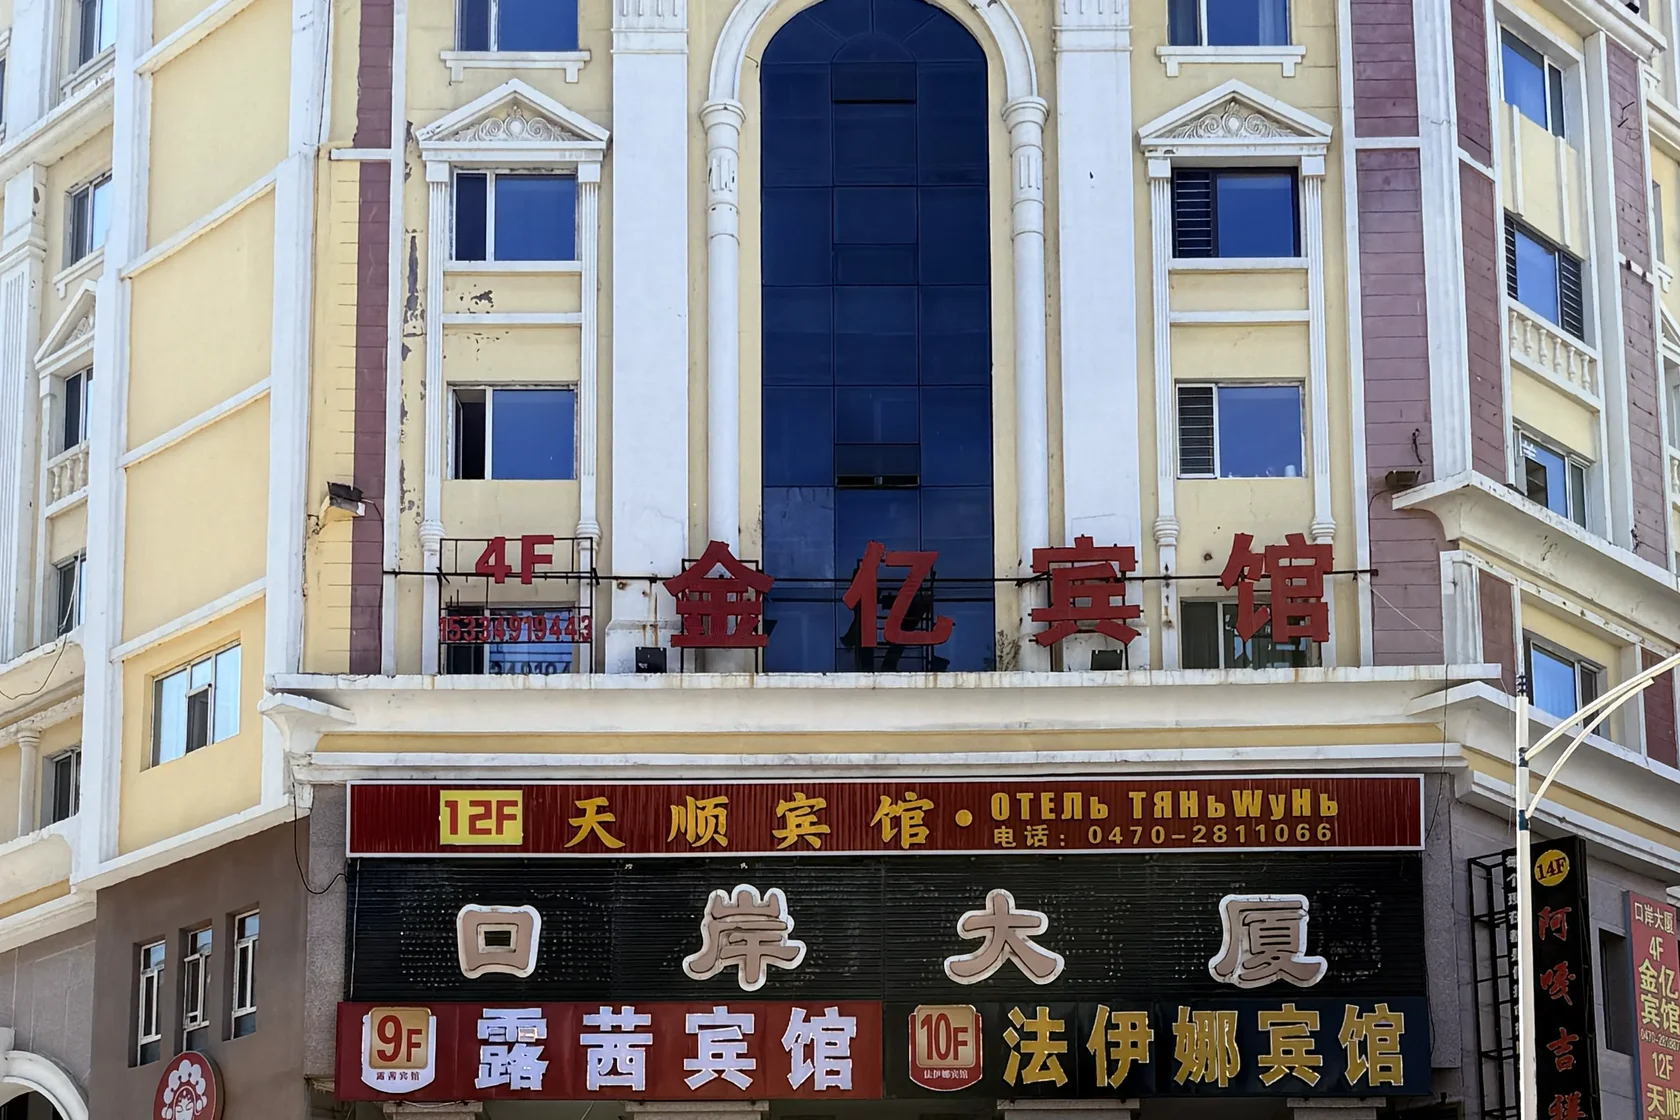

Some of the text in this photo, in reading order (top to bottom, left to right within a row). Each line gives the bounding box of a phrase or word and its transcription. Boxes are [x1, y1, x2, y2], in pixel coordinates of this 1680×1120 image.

[474, 535, 555, 586] 4F
[663, 533, 1334, 648] 金亿宾馆
[444, 799, 520, 838] 12F
[564, 791, 935, 850] 天顺宾馆
[1088, 822, 1333, 846] 0470-2811066
[1536, 856, 1567, 880] 14F
[456, 883, 1328, 992] 口岸大厦
[1634, 900, 1676, 935] 口岸大厦
[1648, 936, 1665, 962] 4F
[375, 1014, 424, 1064] 9F
[475, 1004, 857, 1092] 露茜宾馆
[919, 1012, 969, 1062] 10F
[1001, 1002, 1405, 1089] 法伊娜宾馆
[1651, 1051, 1674, 1080] 12F
